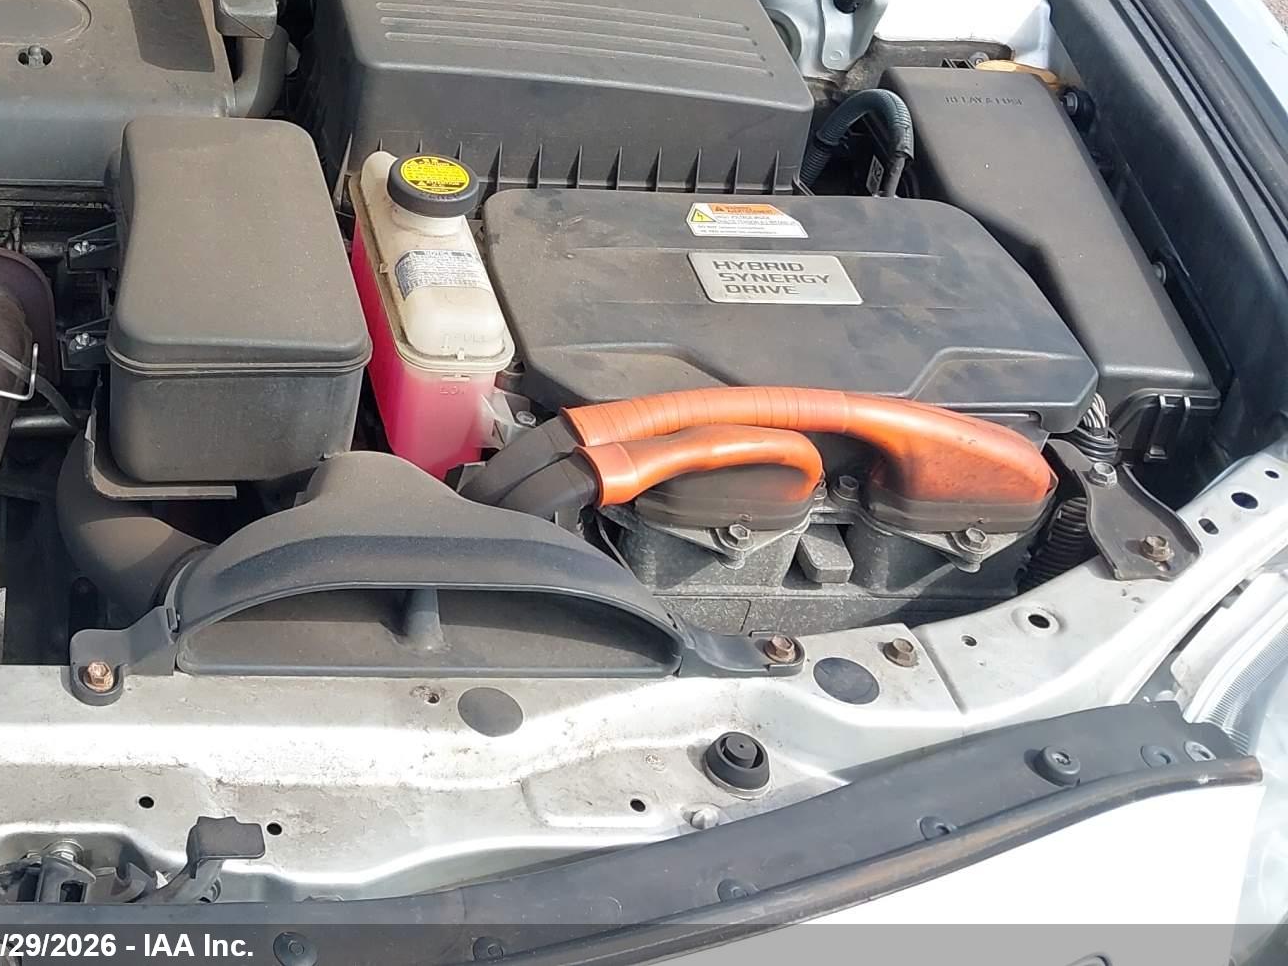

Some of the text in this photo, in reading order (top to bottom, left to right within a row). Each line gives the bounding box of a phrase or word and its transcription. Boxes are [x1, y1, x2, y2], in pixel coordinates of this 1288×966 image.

[713, 260, 805, 272] HYBRID
[718, 272, 831, 284] SYNERGY
[725, 284, 800, 295] DRIVE
